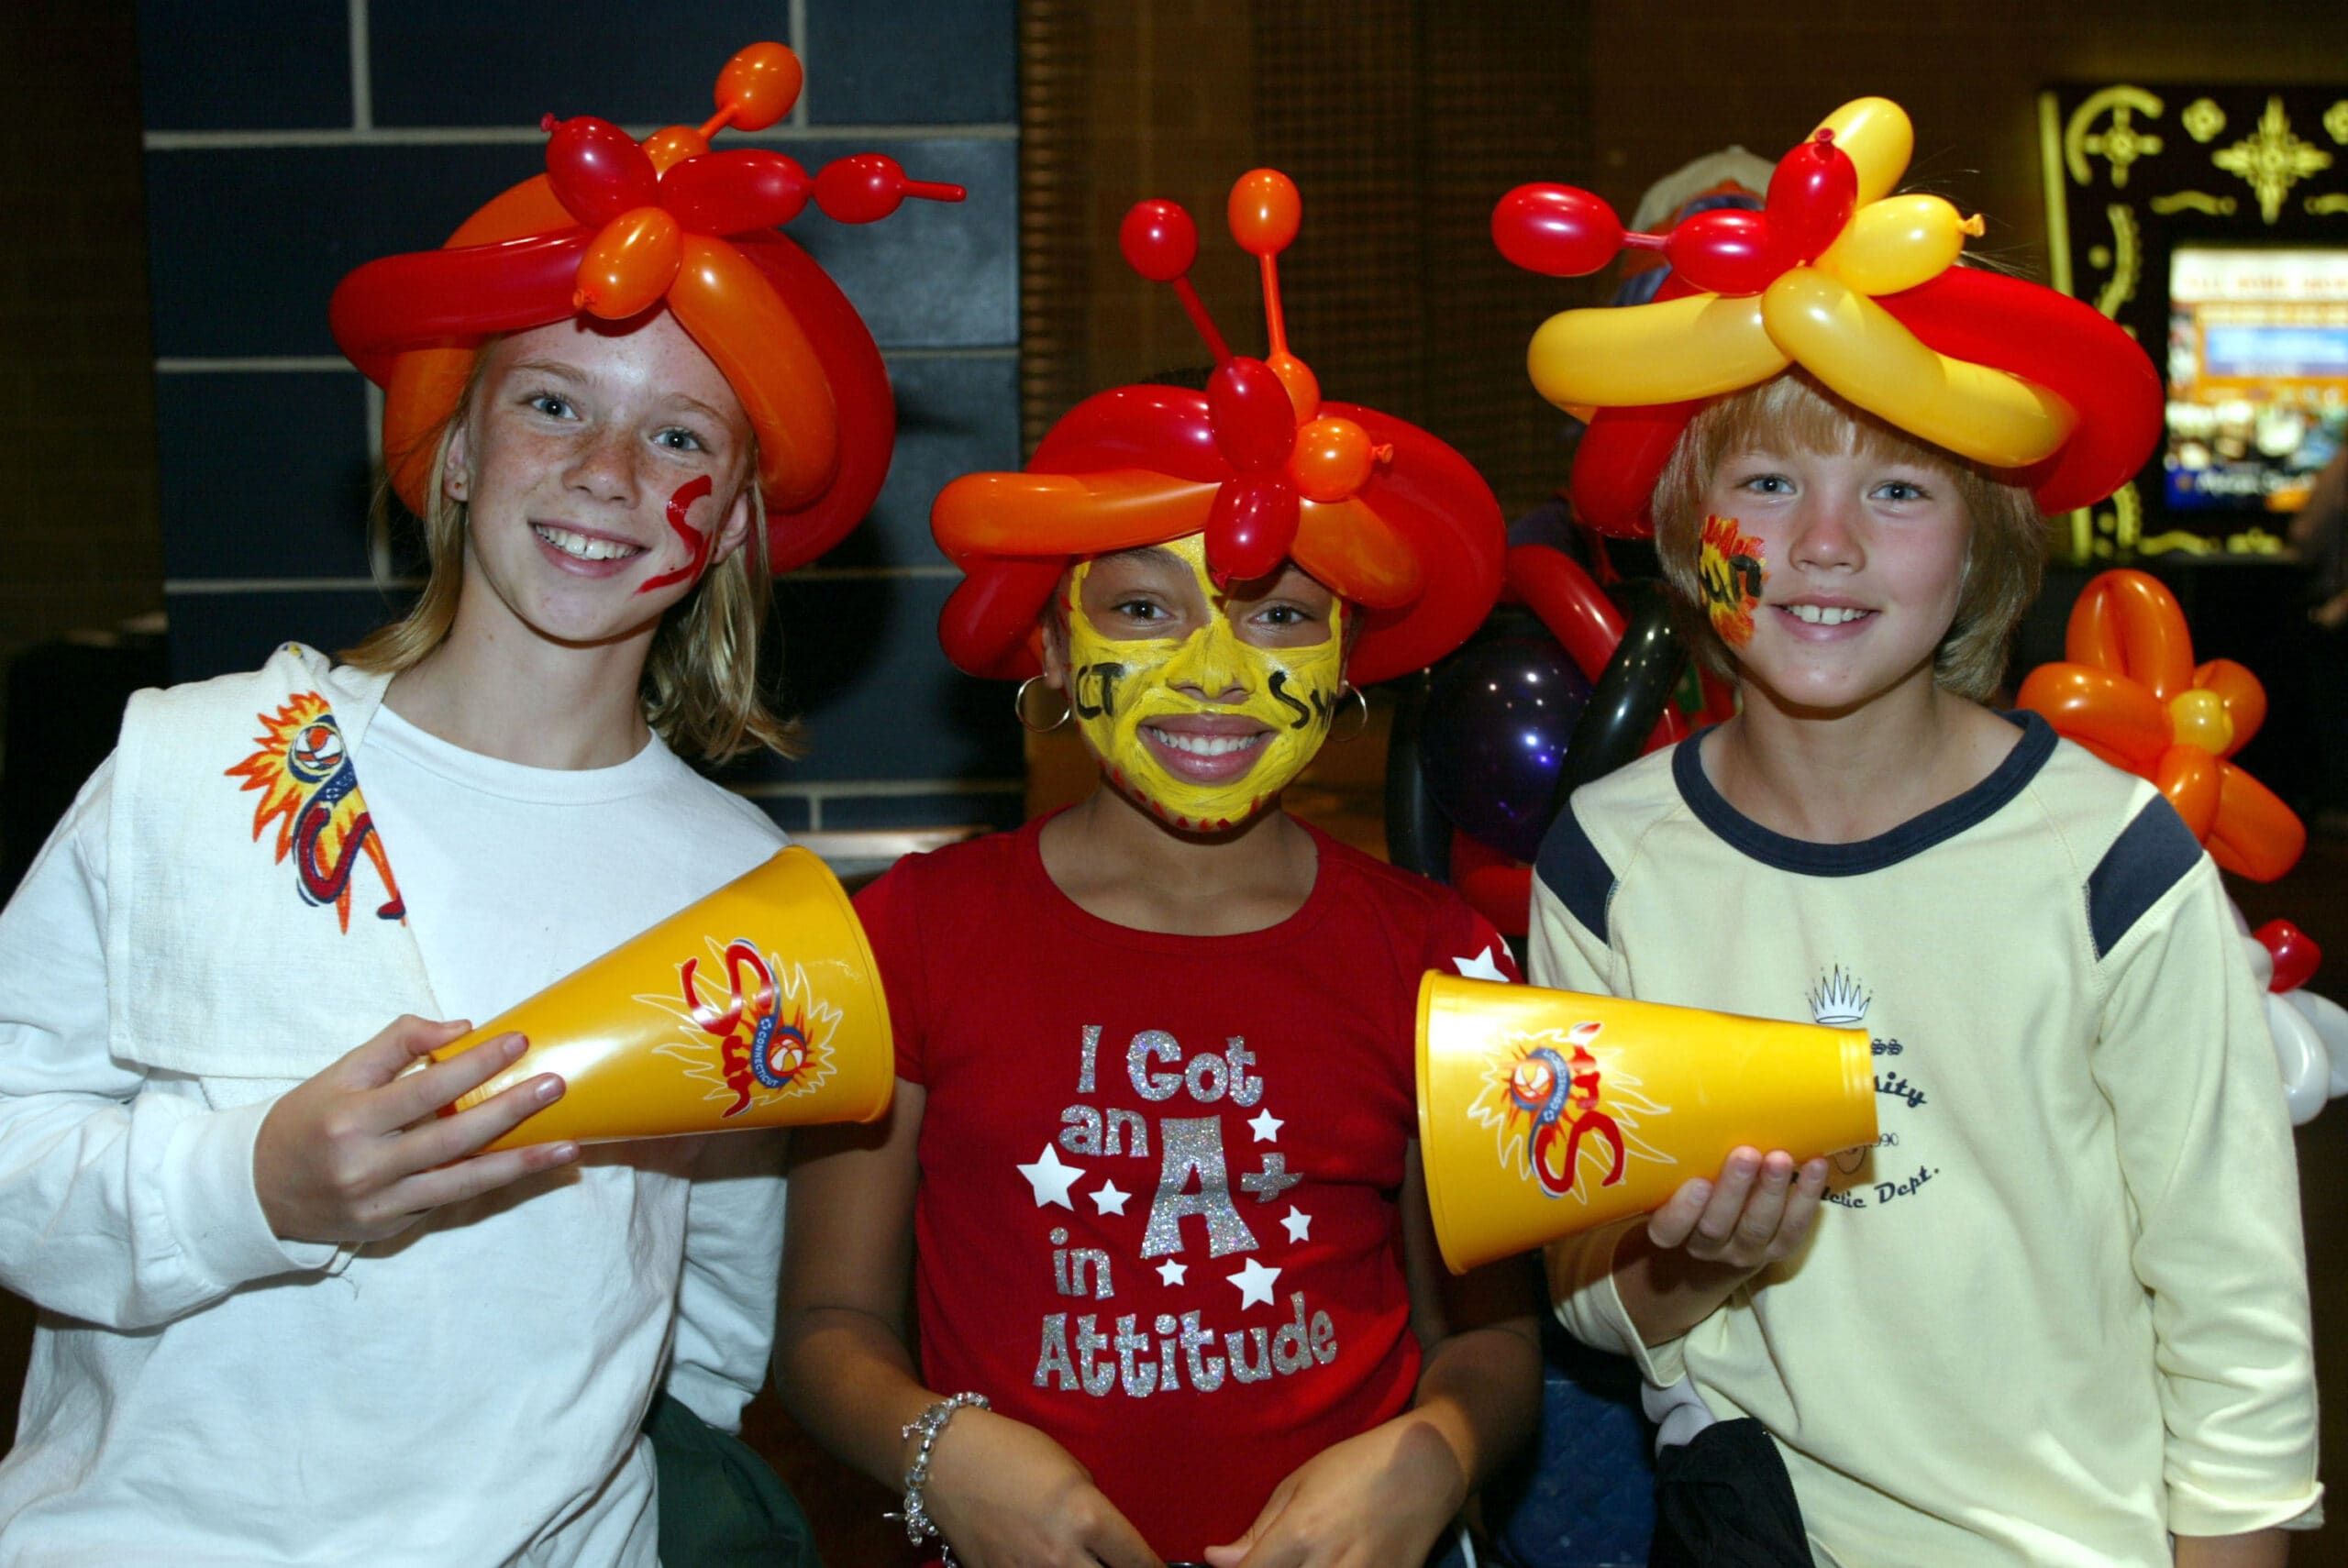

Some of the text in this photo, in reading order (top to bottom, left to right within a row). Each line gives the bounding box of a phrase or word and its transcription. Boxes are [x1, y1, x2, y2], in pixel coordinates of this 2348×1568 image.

[1076, 662, 1124, 719] CT
[1077, 1024, 1264, 1107] I Got
[1058, 1104, 1150, 1158] an
[1874, 1165, 1941, 1204] Dept.
[1048, 1226, 1115, 1301] in
[1032, 1290, 1338, 1399] Attitude
